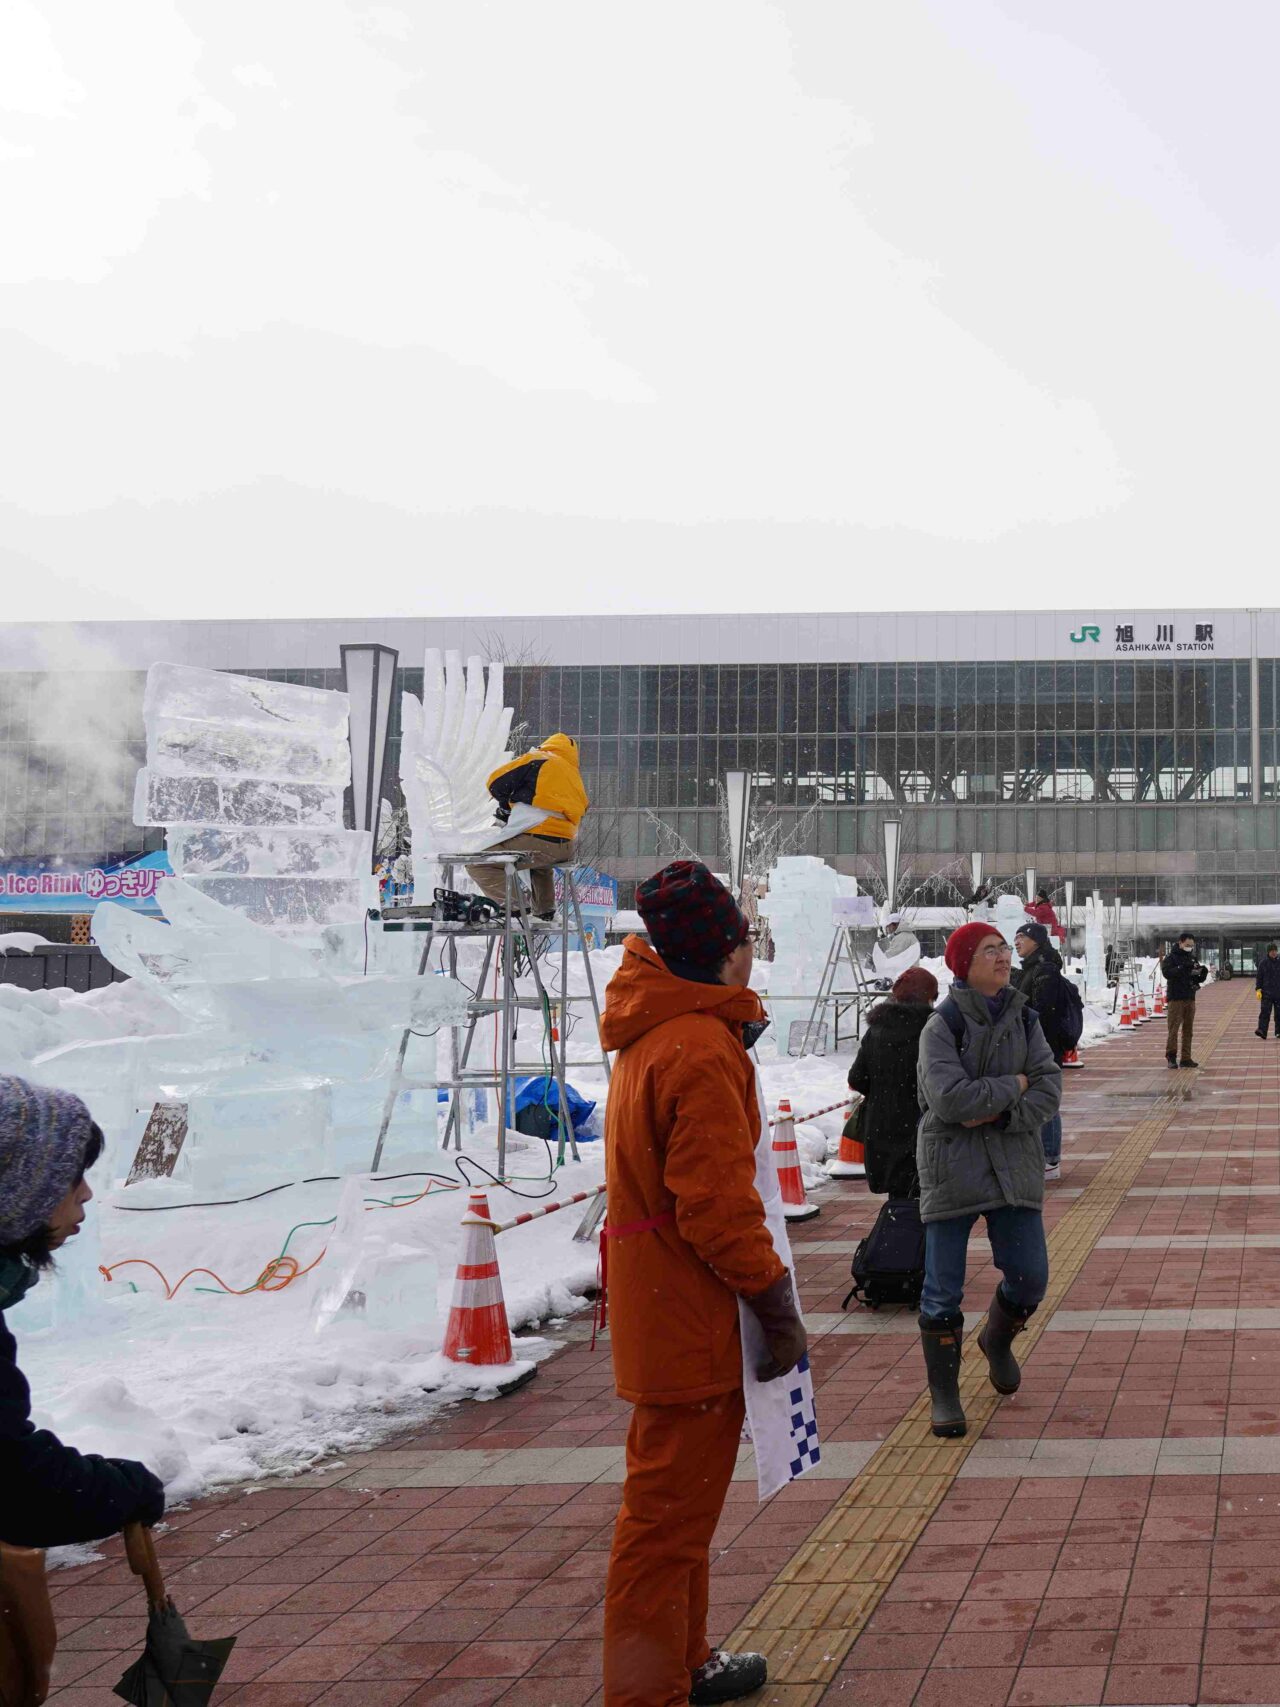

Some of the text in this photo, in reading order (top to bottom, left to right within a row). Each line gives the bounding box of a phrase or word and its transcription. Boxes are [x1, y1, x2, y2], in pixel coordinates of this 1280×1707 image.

[1070, 624, 1214, 643] JR 旭川駅
[1116, 643, 1214, 652] ASAHIKAWA STATION
[8, 873, 39, 895] Ice
[41, 873, 83, 895] Rink
